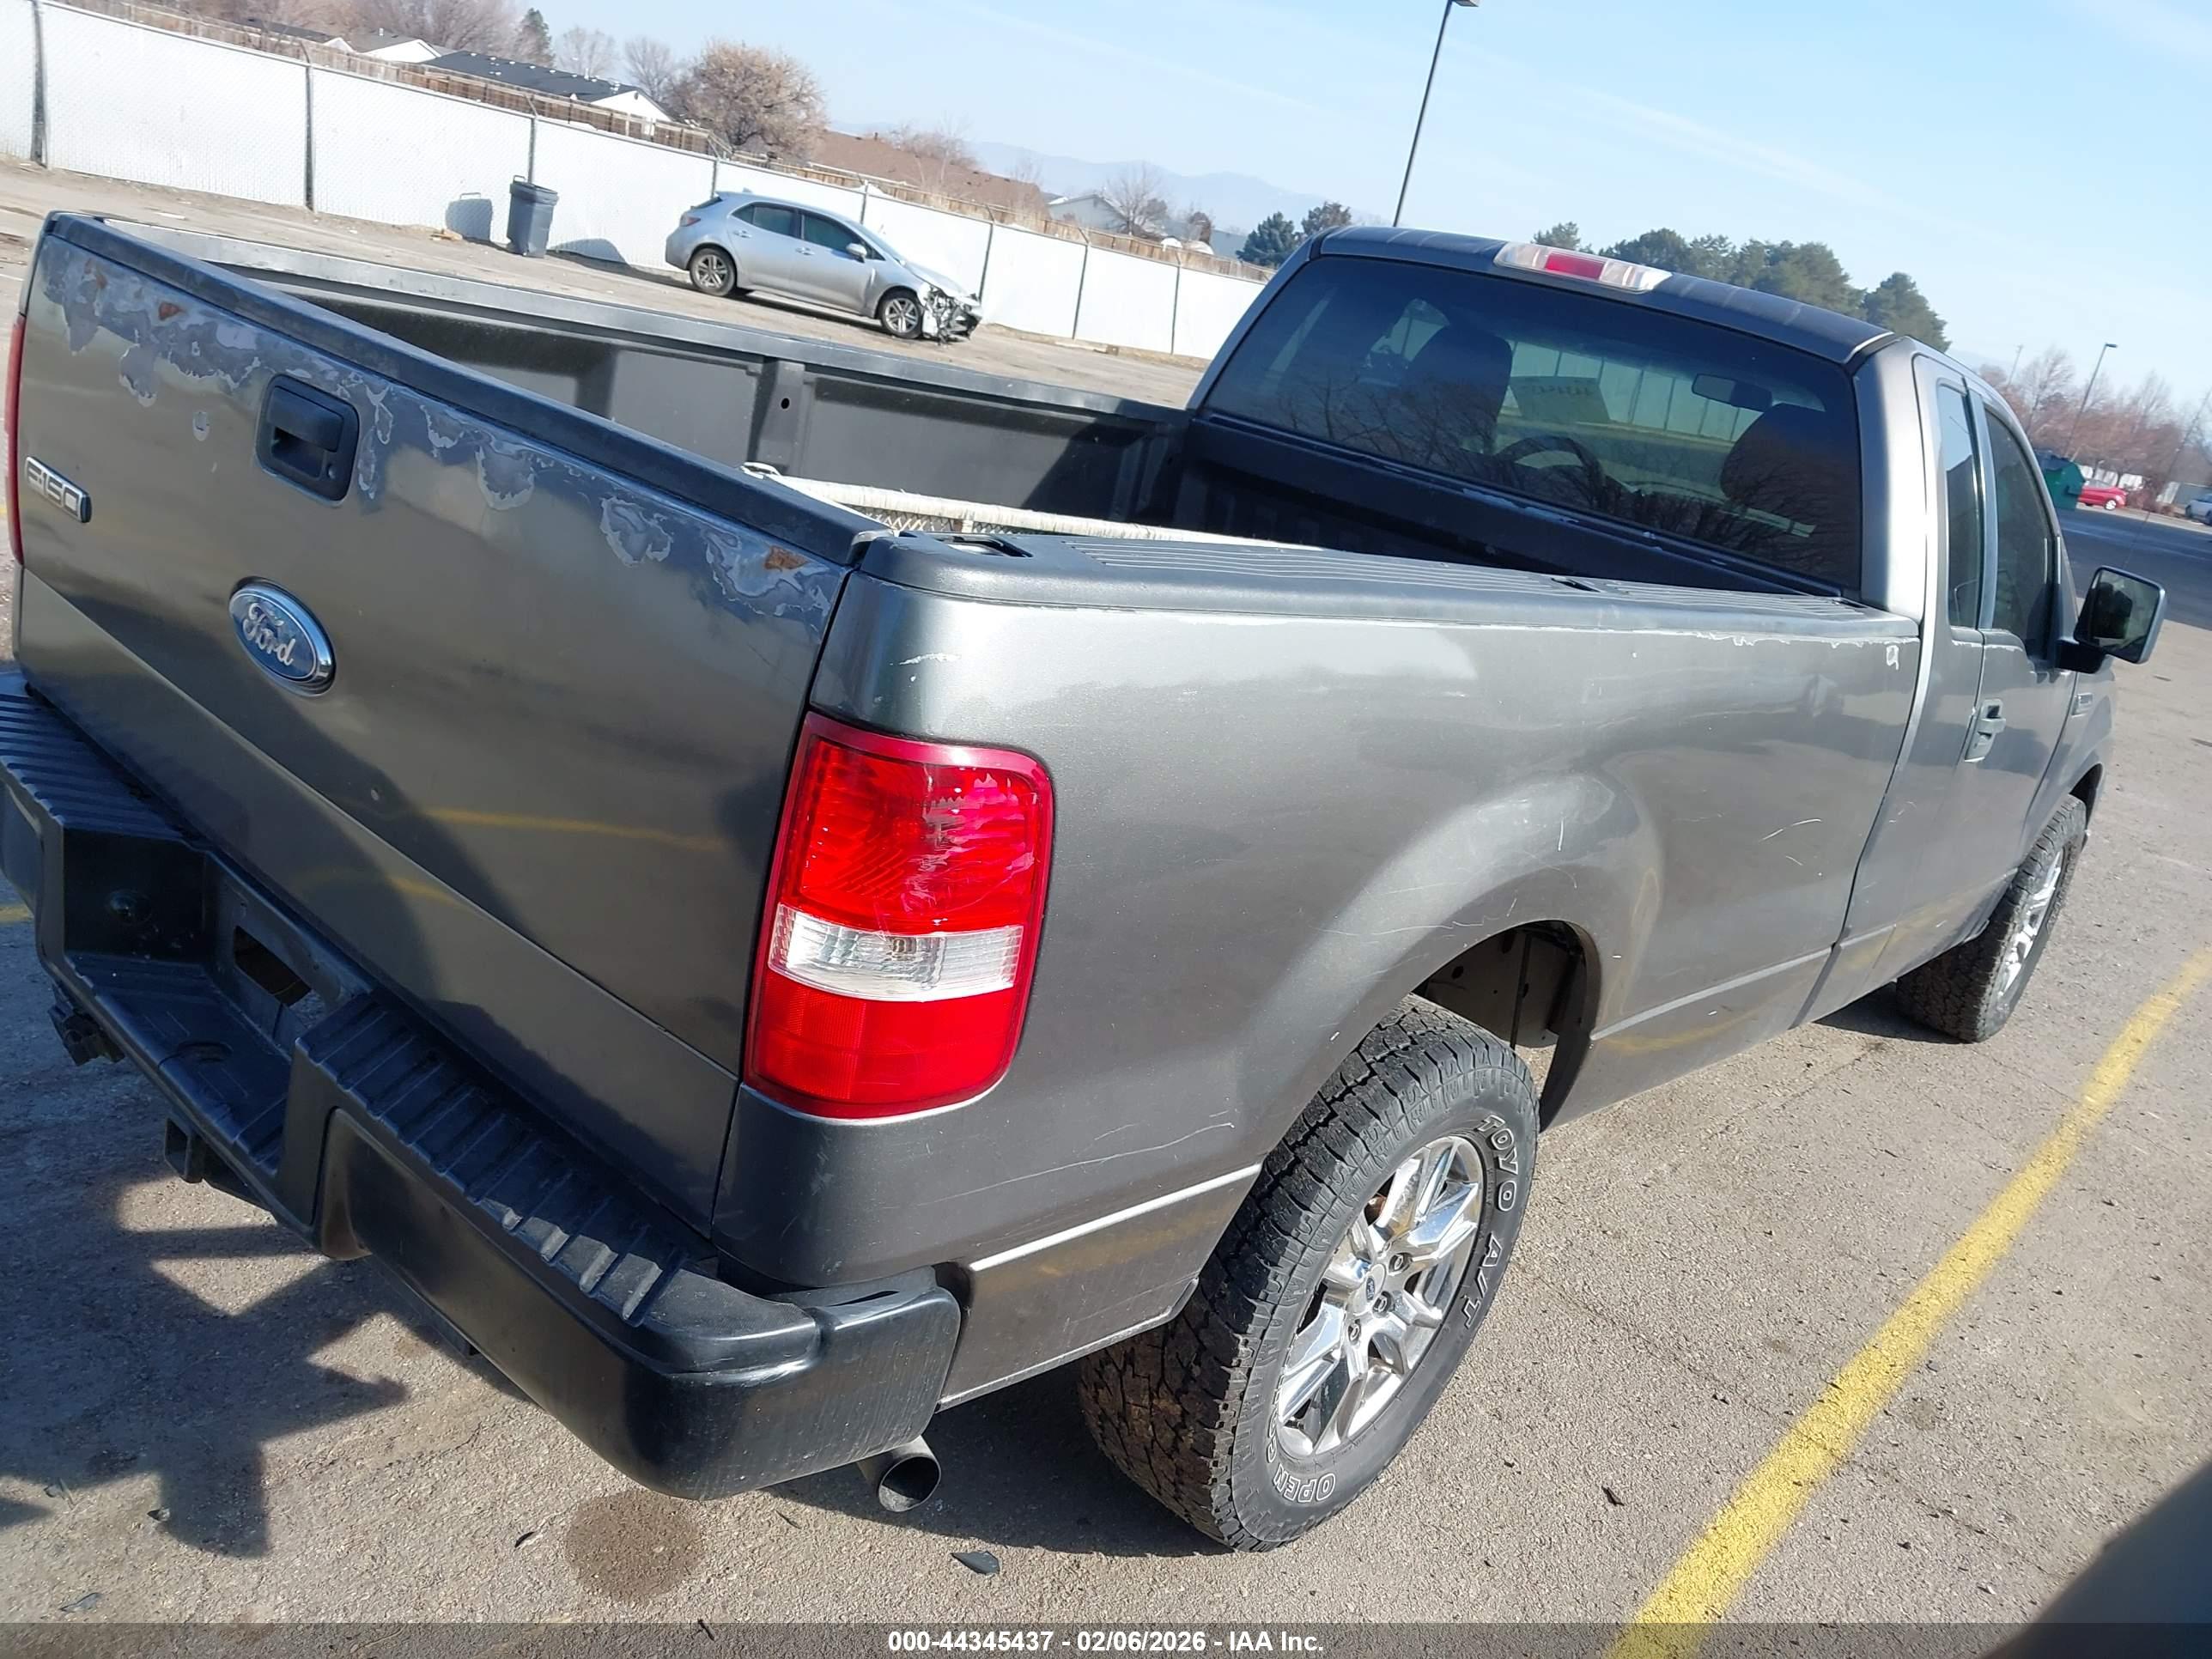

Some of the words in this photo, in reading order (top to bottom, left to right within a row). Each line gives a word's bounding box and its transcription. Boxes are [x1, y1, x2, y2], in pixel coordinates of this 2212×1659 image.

[242, 602, 296, 666] Ford
[1476, 1115, 1519, 1212] TOYO
[1462, 1231, 1503, 1329] A/T
[1273, 1462, 1336, 1503] OPEN
